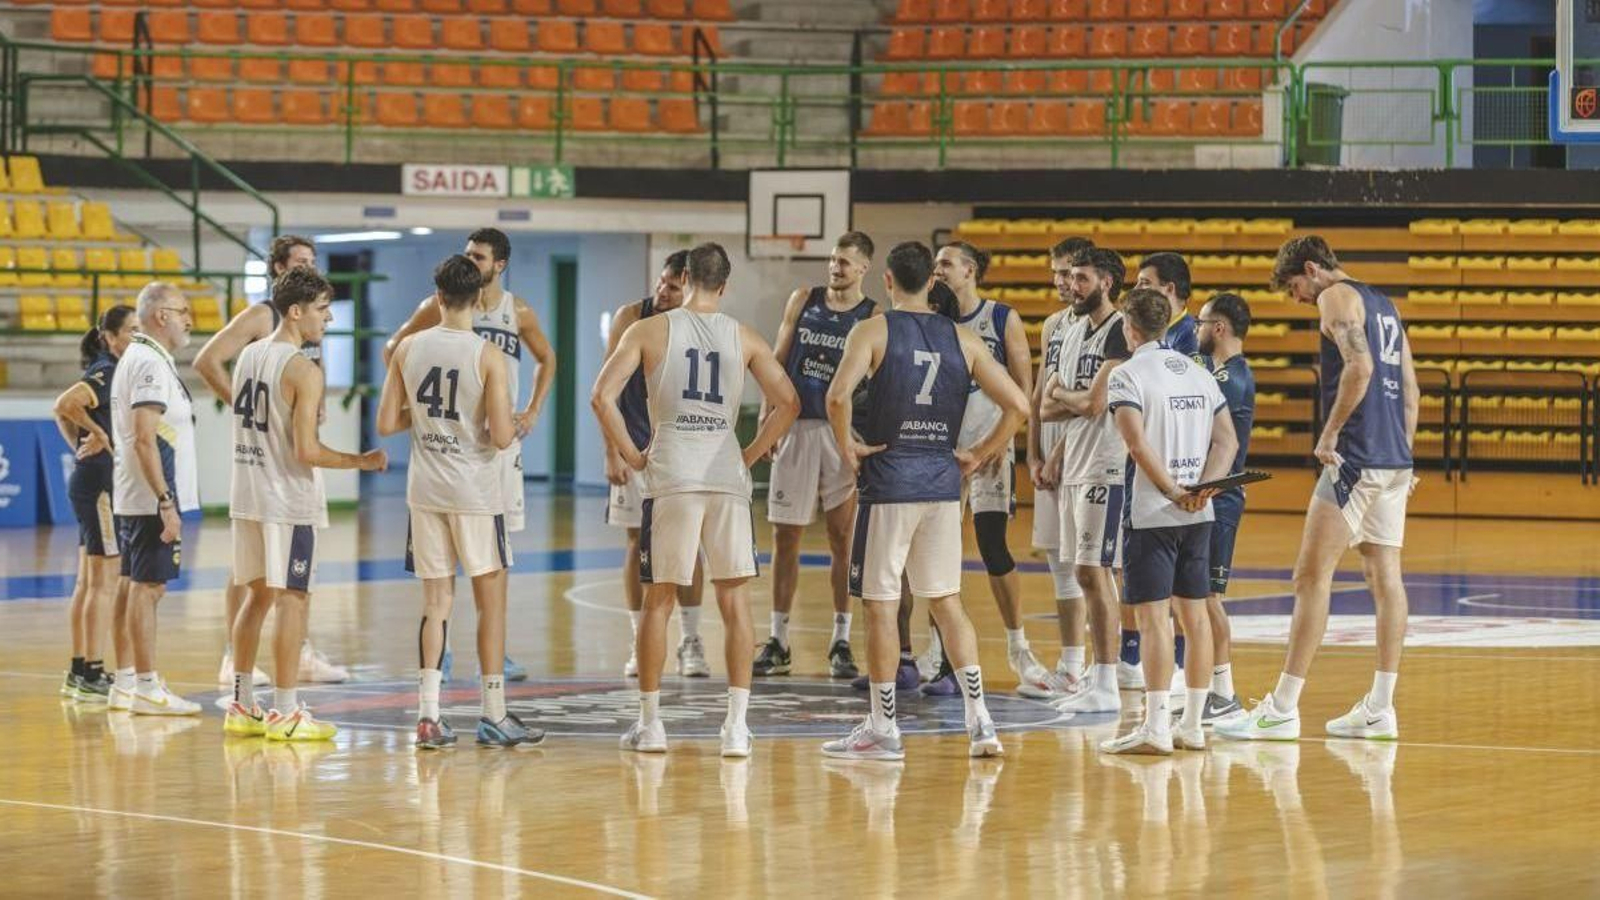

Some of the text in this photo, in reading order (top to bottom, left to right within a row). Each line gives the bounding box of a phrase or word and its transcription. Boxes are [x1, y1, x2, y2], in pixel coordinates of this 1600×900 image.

[413, 169, 499, 192] SAIDA
[1377, 313, 1400, 365] 12
[416, 366, 460, 422] 41
[682, 347, 723, 405] 11
[913, 349, 941, 405] 7
[234, 378, 269, 432] 40
[1085, 486, 1107, 504] 42
